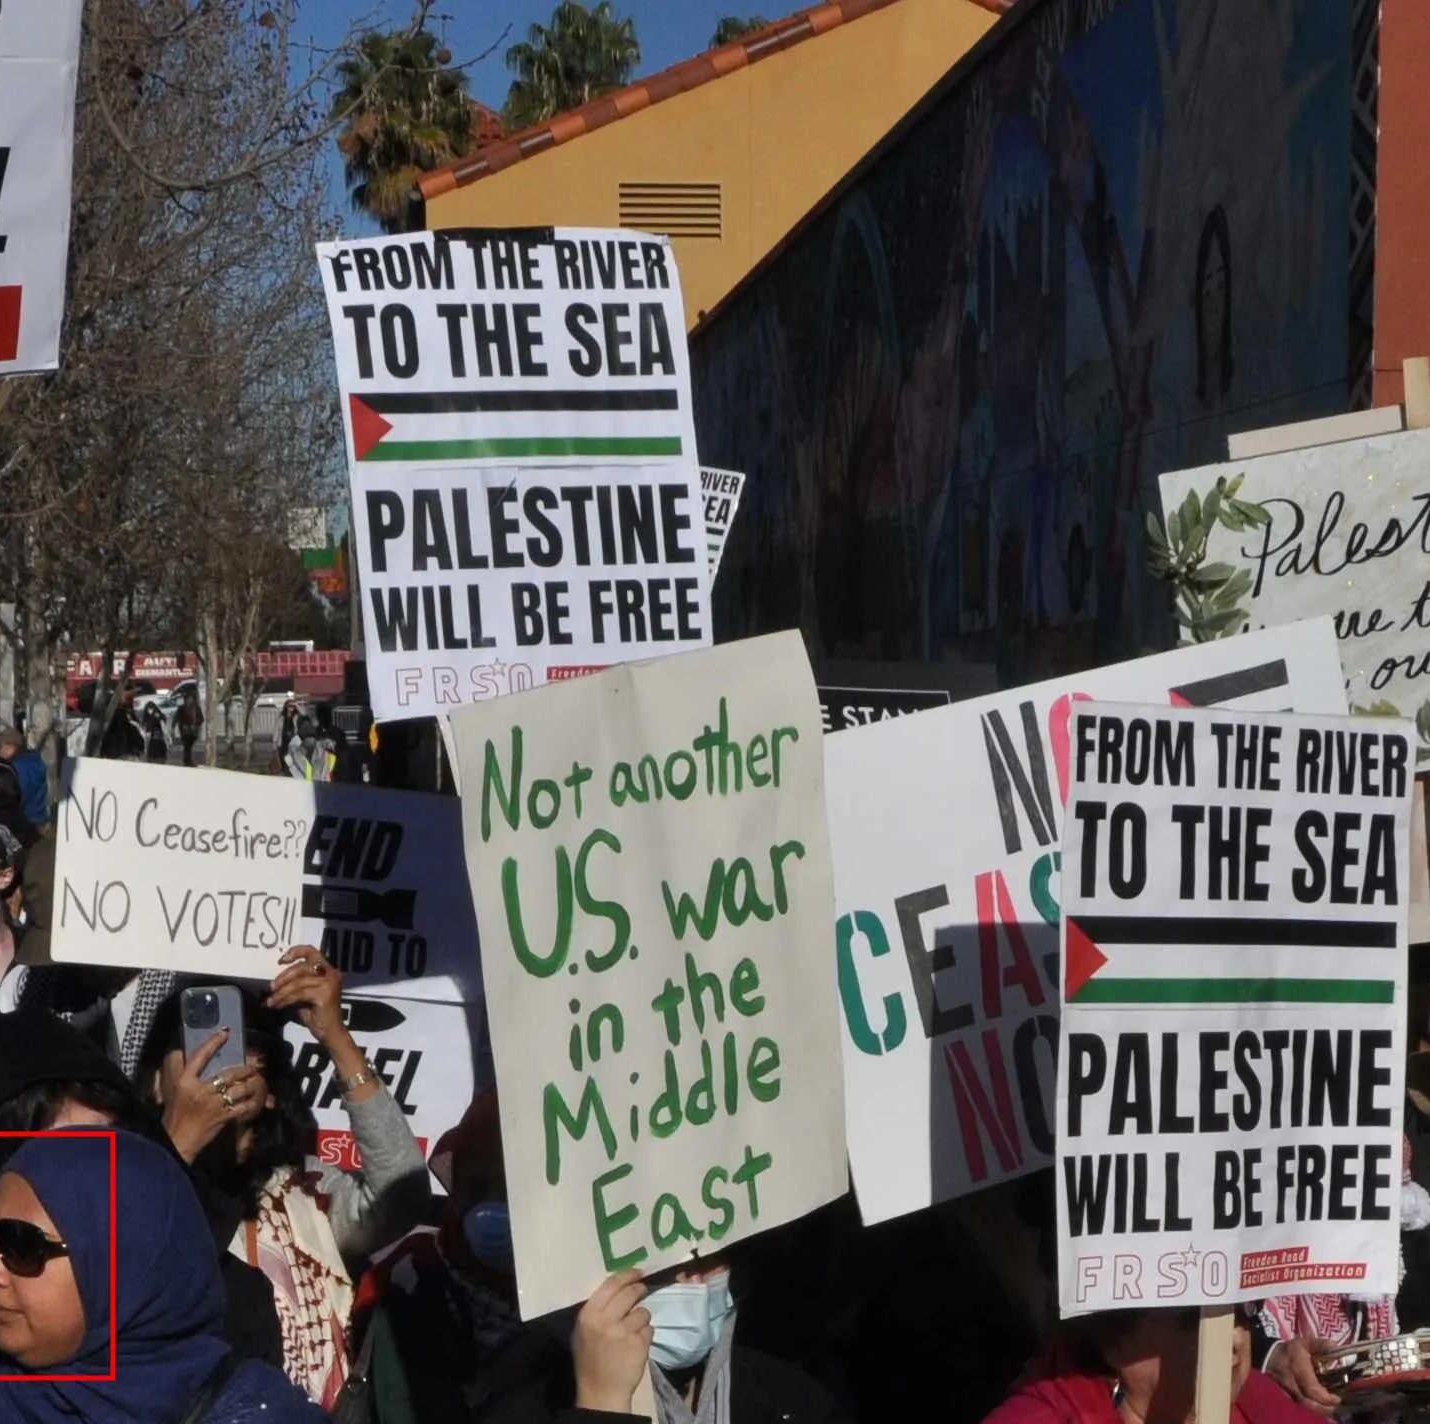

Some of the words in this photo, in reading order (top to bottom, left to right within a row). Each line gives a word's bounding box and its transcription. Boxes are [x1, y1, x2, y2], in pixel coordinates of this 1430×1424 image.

[331, 241, 455, 292] FROM
[471, 240, 546, 290] THE
[554, 239, 670, 290] RIVER
[343, 303, 420, 379] TO
[436, 303, 549, 378] THE
[564, 301, 676, 377] SEA
[365, 484, 696, 573] PALESTINE
[702, 493, 732, 525] EA
[369, 584, 497, 652] WILL
[510, 580, 573, 647] BE
[588, 576, 702, 644] FREE
[842, 704, 920, 730] STA
[1076, 714, 1196, 787] FROM
[1211, 722, 1282, 792] THE
[1296, 726, 1408, 798] RIVER
[481, 725, 593, 842] Not
[609, 696, 800, 808] another
[64, 786, 118, 842] NO
[135, 797, 308, 860] Ceasefire??
[302, 815, 405, 882] END
[1075, 801, 1148, 900] TO
[1171, 804, 1274, 903] THE
[1292, 808, 1399, 906] SEA
[61, 877, 131, 933] NO
[156, 885, 298, 952] VOTES!!
[501, 828, 639, 978] U.S.
[661, 838, 806, 942] war
[387, 933, 428, 979] TO
[568, 997, 624, 1072] in
[651, 951, 766, 1047] the
[543, 1030, 783, 1186] Middle
[1068, 1028, 1393, 1138] PALESTINE
[591, 1144, 773, 1274] East
[1063, 1150, 1193, 1238] WILL
[1212, 1146, 1263, 1231] BE
[1276, 1143, 1392, 1226] FREE
[1076, 1250, 1229, 1303] FRSO
[1283, 1266, 1364, 1282] Organization
